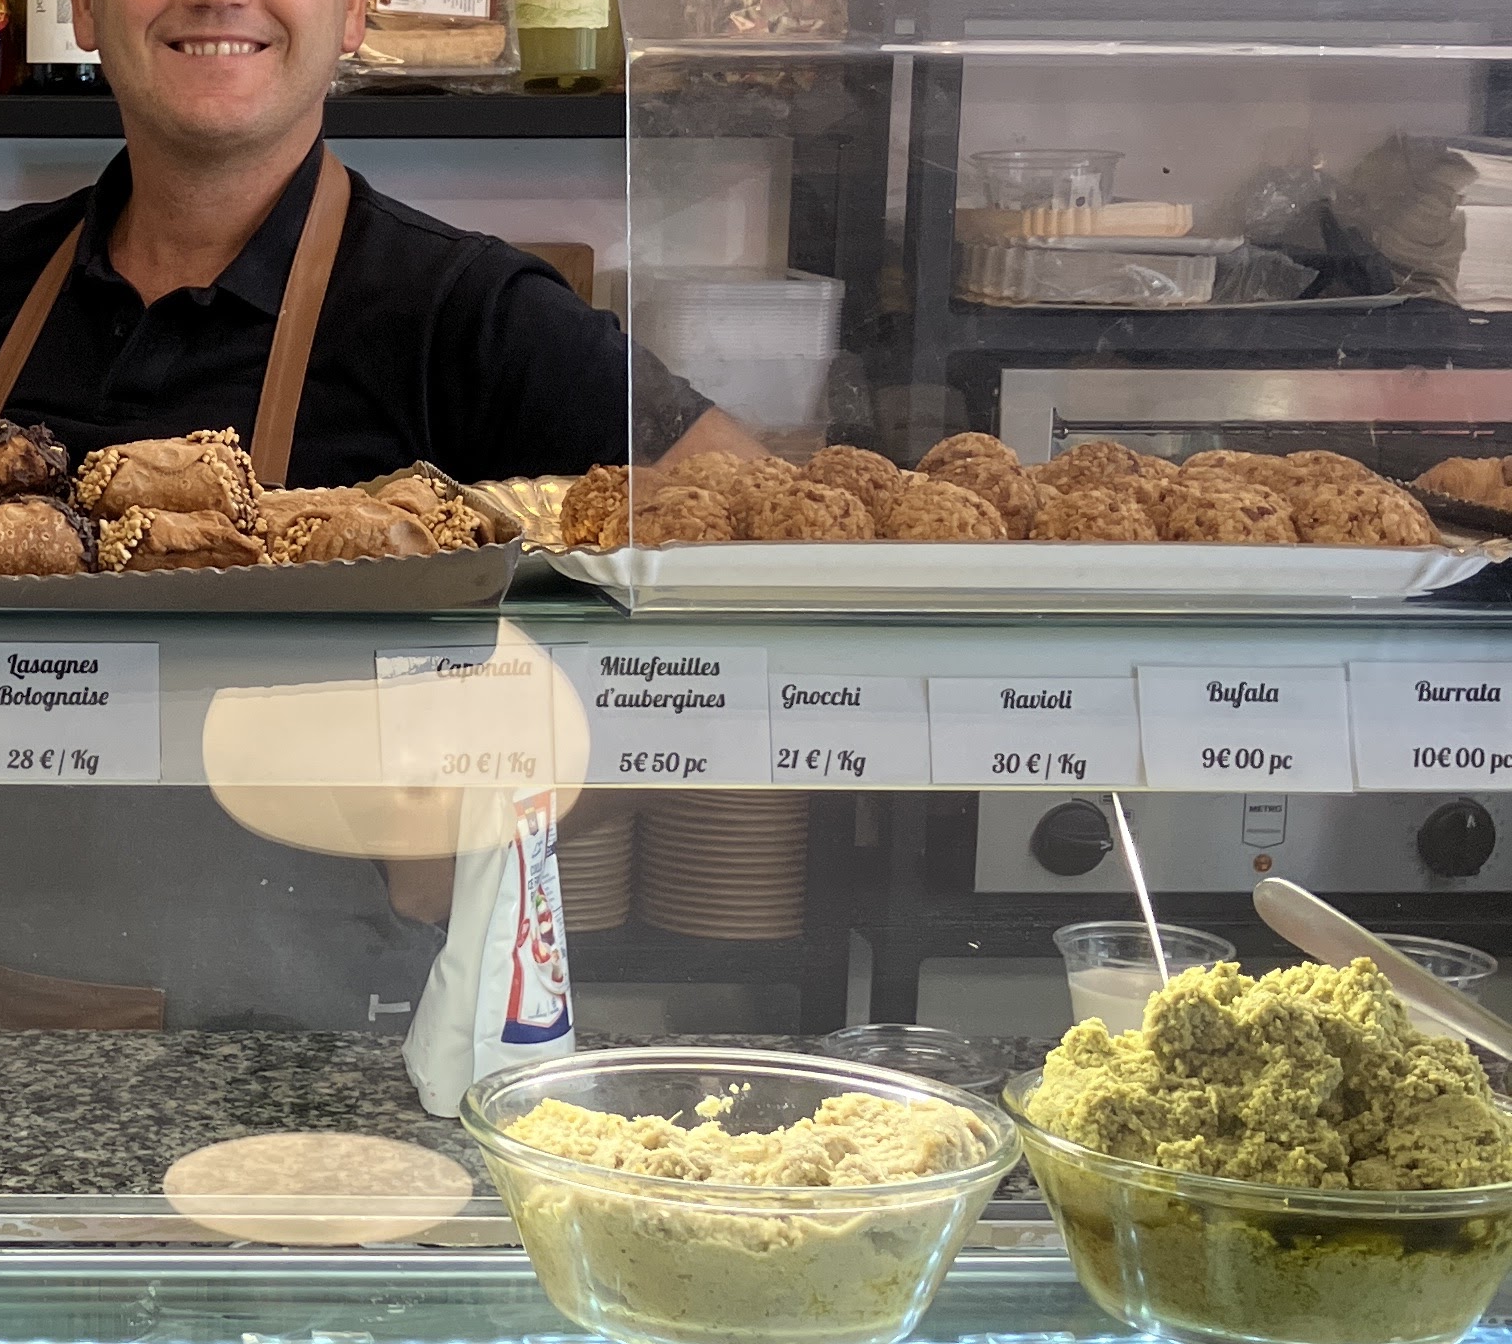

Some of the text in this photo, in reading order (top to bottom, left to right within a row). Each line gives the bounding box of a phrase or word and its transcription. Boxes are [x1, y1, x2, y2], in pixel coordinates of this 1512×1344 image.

[6, 653, 100, 681] Lasagnes
[435, 656, 533, 682] Caponata
[599, 655, 721, 682] Millefeuilles
[595, 687, 726, 715] d'aubergines
[781, 683, 862, 709] Gnocchi
[999, 686, 1073, 711] Ravioli
[1205, 680, 1280, 709] Bufala
[1414, 679, 1502, 704] Burrata
[6, 747, 100, 776] 28 € / Kg
[441, 750, 537, 779] 30 € / Kg
[618, 751, 708, 781] 5€ 50 pc
[776, 746, 867, 778] 21 € / Kg
[991, 750, 1088, 781] 30 € / Kg
[1201, 747, 1294, 776] 9€ 00 pc
[1411, 746, 1512, 775] 10€ 00 pc
[1248, 805, 1283, 814] METRO
